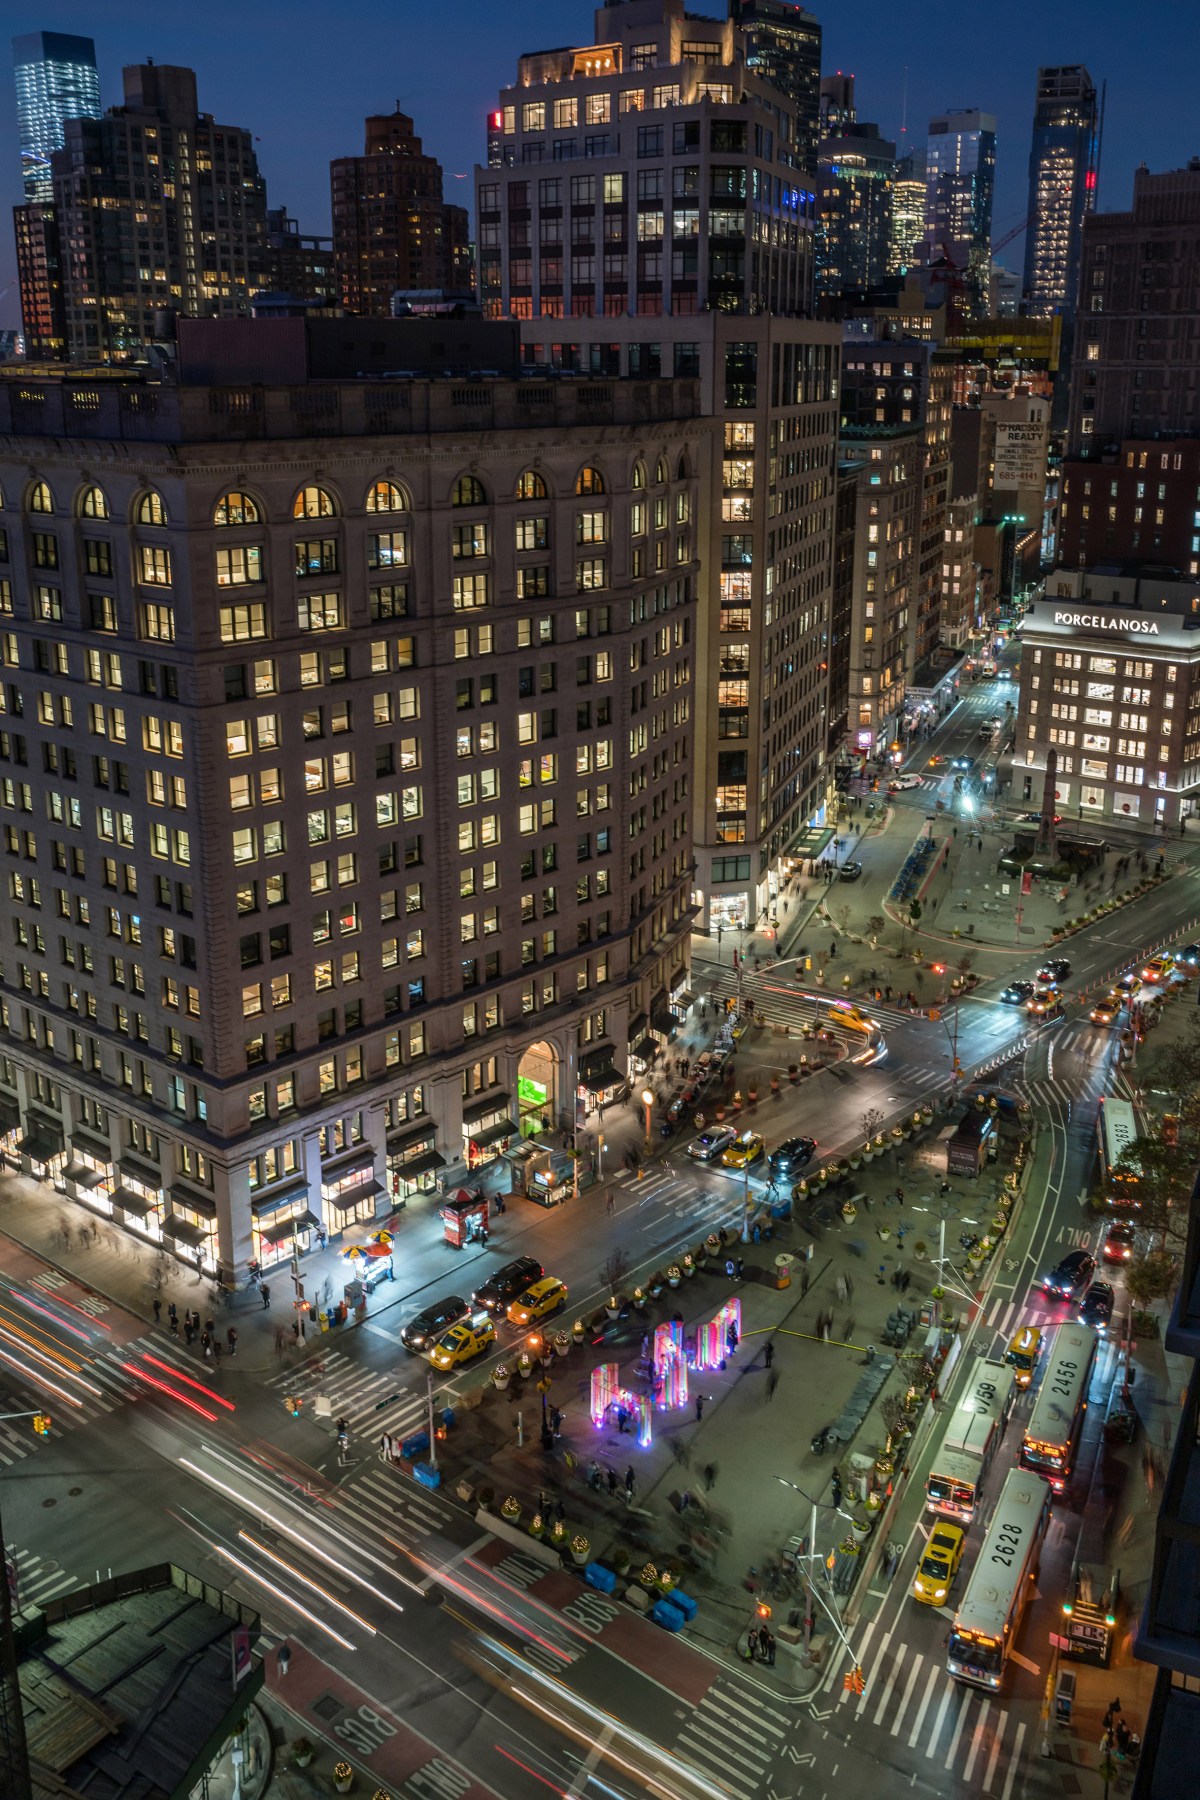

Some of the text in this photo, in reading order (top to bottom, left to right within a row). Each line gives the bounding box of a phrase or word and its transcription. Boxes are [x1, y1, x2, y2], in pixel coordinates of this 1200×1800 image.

[1008, 432, 1044, 441] REALTY
[1000, 472, 1037, 480] 685-4141
[1054, 612, 1159, 634] PORCELANOSA
[1055, 1225, 1091, 1249] ONLY
[27, 1270, 70, 1293] ONLY
[74, 1296, 110, 1317] BUS
[1052, 1360, 1078, 1397] 2456
[991, 1523, 1023, 1567] 2628
[492, 1553, 550, 1589] ONLY
[561, 1592, 620, 1634] BUS
[334, 1704, 398, 1755] BUS
